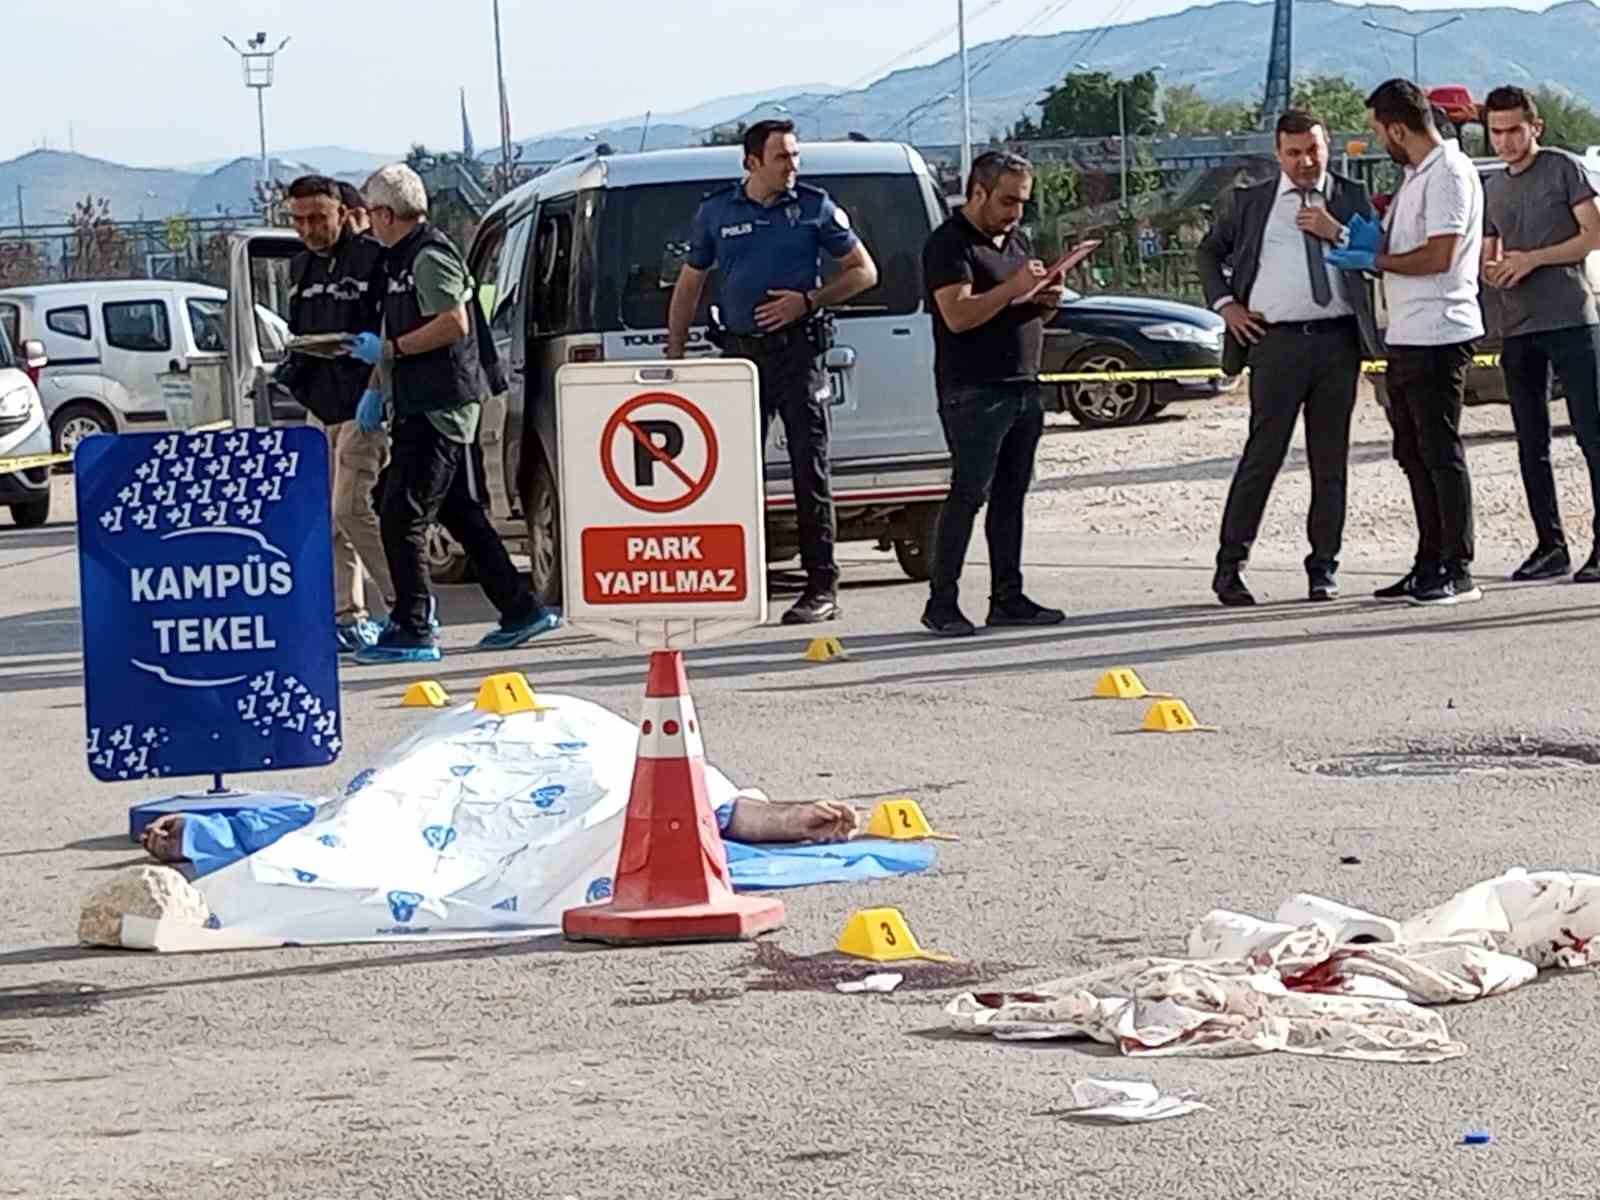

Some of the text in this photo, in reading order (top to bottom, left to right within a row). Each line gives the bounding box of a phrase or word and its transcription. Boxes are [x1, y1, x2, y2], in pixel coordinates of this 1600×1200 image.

[154, 430, 284, 460] +1 +1 +1 +1
[630, 419, 684, 487] P
[135, 452, 299, 483] +1 +1 +1 +1 +1
[117, 476, 282, 507] +1 +1 +1 +1 +1
[99, 499, 263, 532] +1 +1 +1 +1 +1
[626, 536, 703, 561] PARK
[130, 554, 293, 602] KAMPÜS
[594, 568, 737, 595] YAPILMAZ
[152, 615, 277, 653] TEKEL
[505, 682, 518, 703] 1
[898, 808, 912, 828] 2
[880, 921, 896, 946] 3
